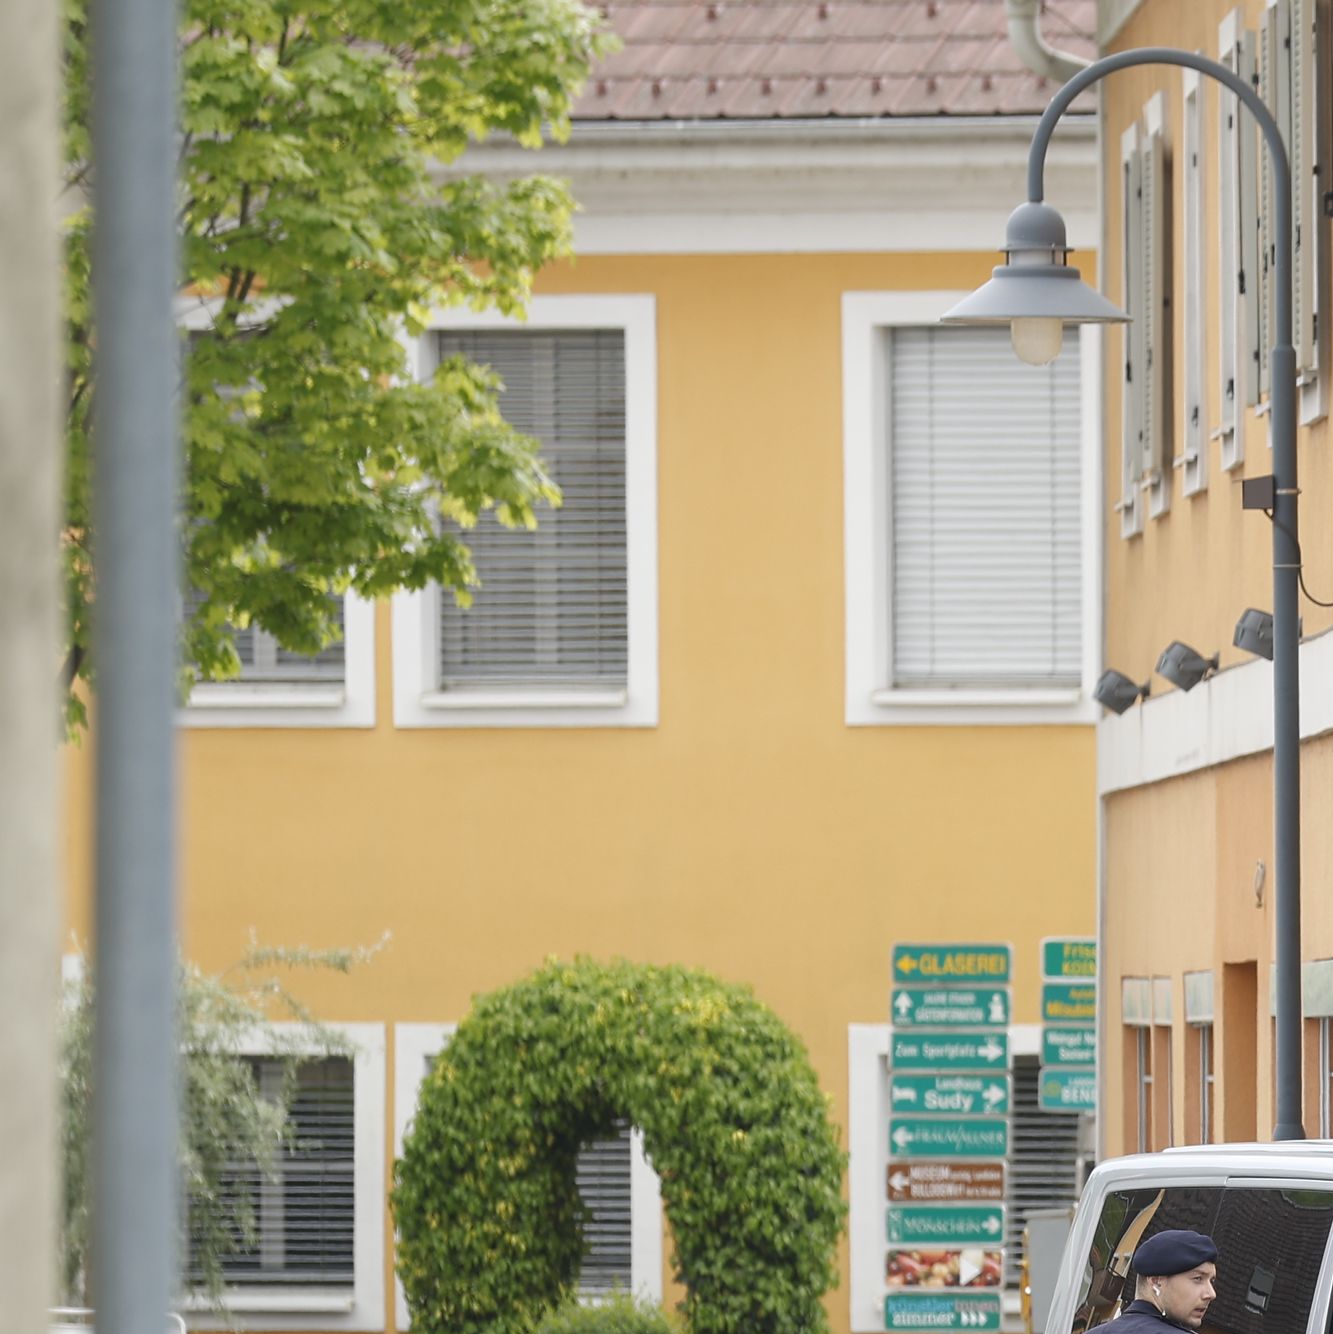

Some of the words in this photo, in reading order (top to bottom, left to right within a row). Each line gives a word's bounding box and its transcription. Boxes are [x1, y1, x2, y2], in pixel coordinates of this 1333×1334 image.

[920, 953, 1006, 975] GLASEREI
[895, 1042, 918, 1057] Zum
[922, 1042, 977, 1060] Sportplatz
[924, 1090, 973, 1112] Sudy
